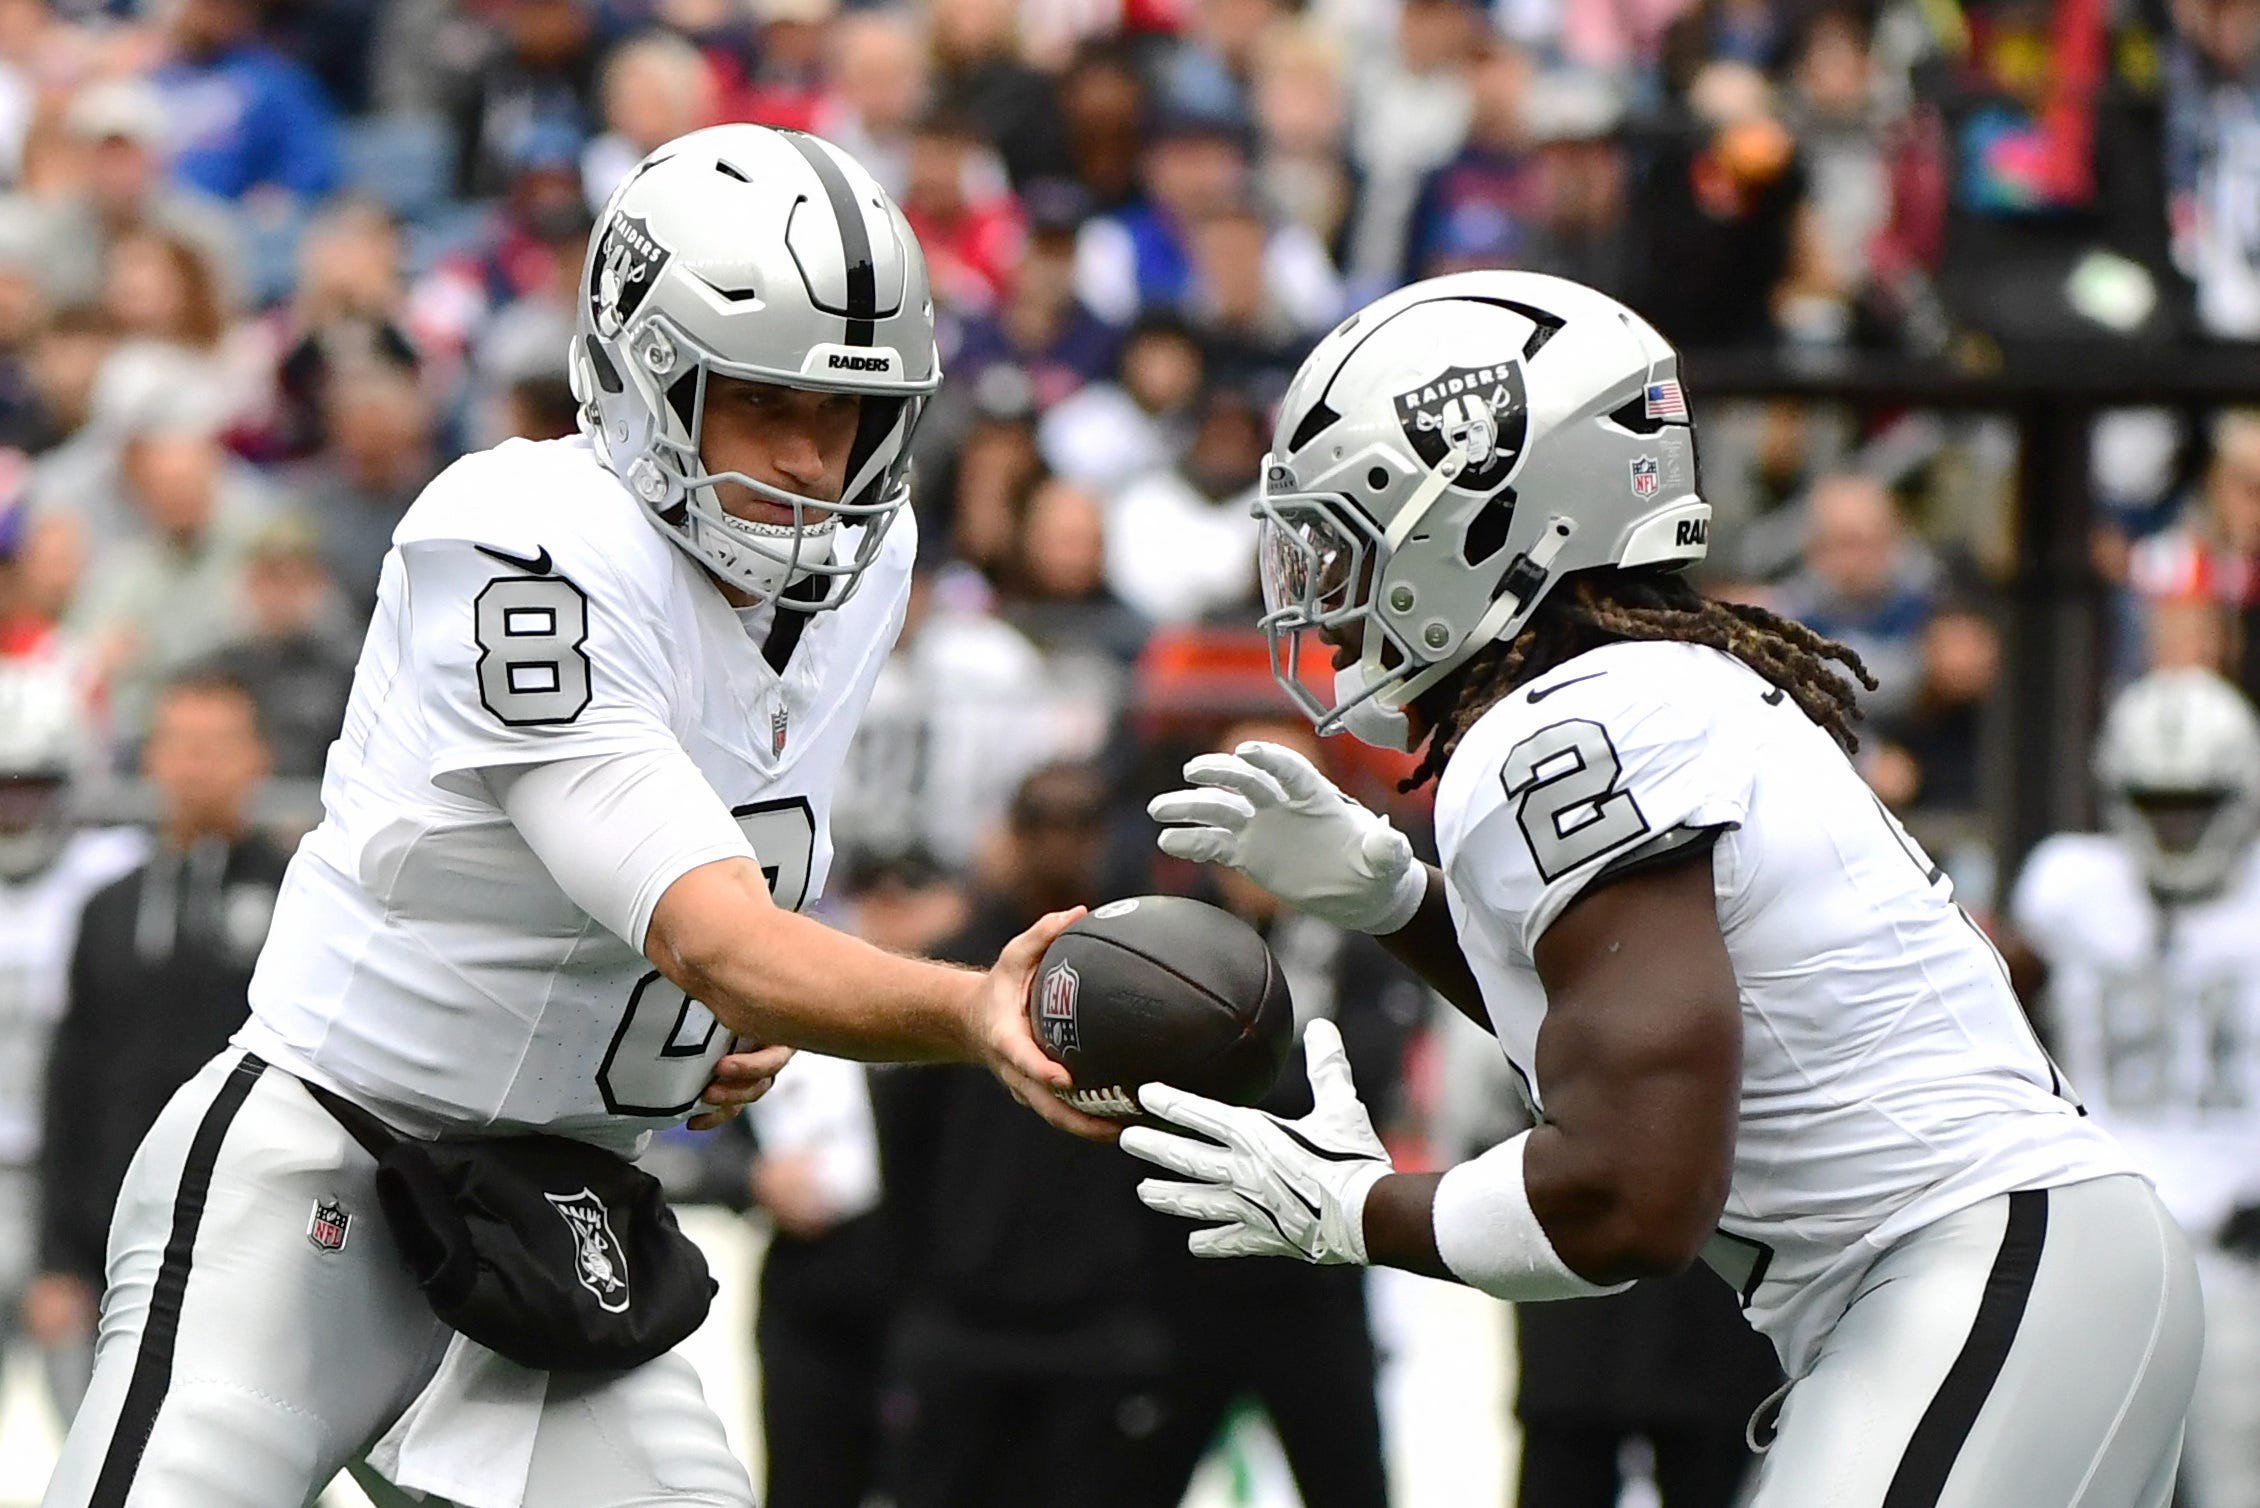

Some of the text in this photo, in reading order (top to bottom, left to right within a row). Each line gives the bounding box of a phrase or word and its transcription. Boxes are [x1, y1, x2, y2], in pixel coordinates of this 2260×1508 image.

[614, 211, 661, 262] RAIDERS
[828, 354, 889, 372] RAIDERS
[1405, 364, 1509, 409] RAIDERS
[1636, 475, 1657, 494] NFL
[474, 576, 593, 726] 8
[1499, 717, 1651, 886] 2
[1046, 974, 1073, 1016] NFL
[316, 1221, 340, 1245] NFL
